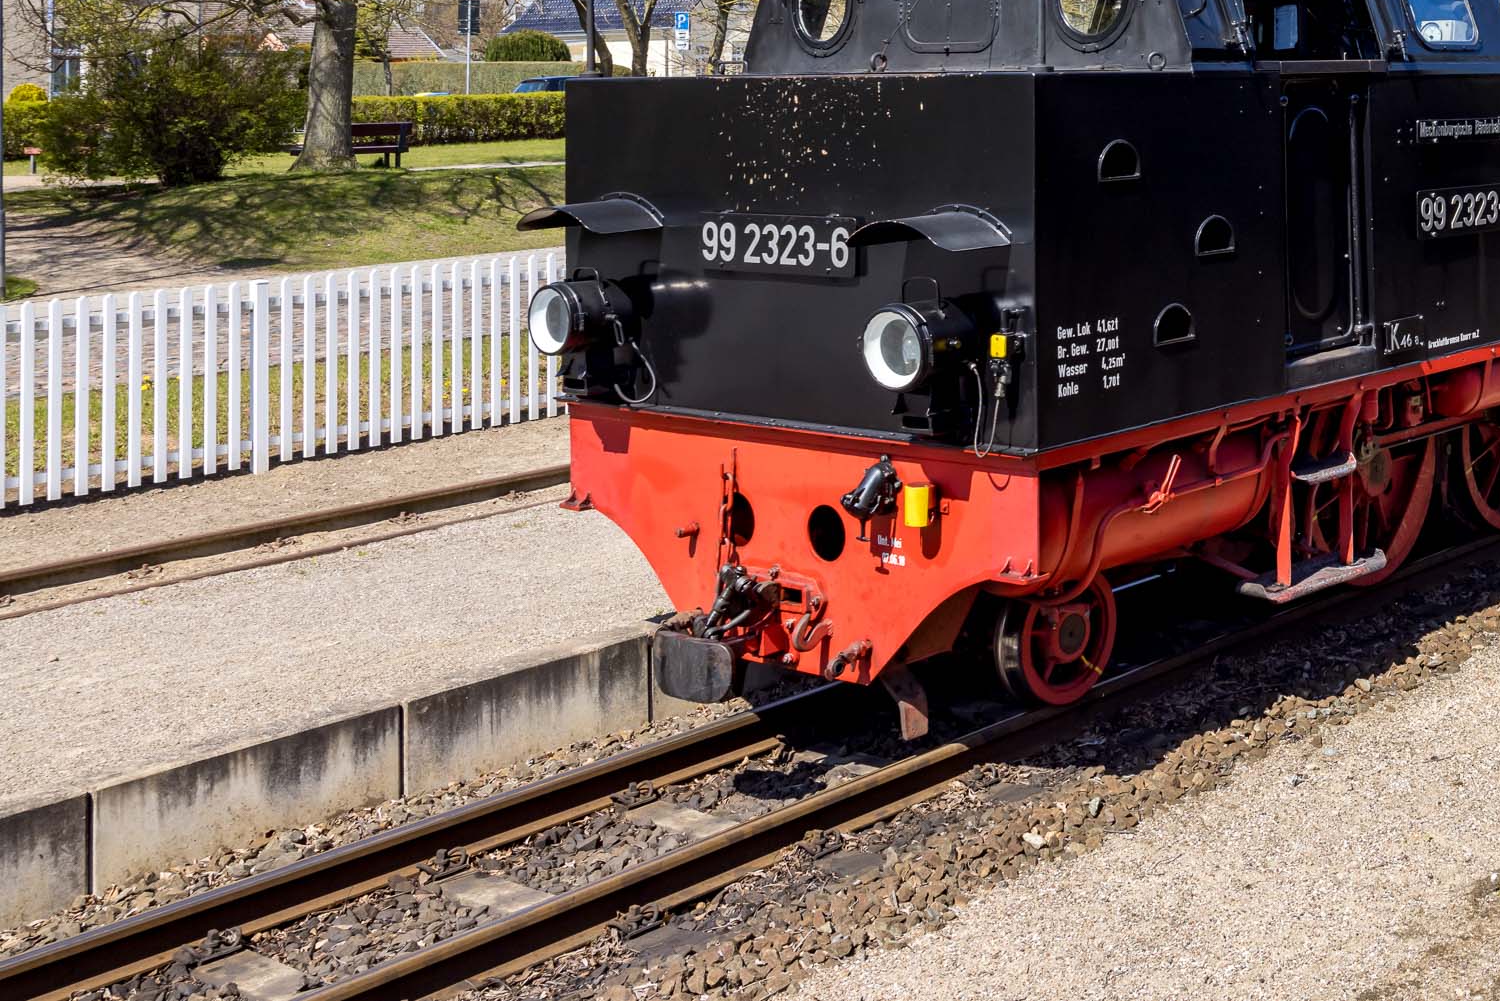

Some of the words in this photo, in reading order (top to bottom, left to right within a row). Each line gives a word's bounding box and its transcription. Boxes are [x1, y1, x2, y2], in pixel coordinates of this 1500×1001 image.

[1421, 196, 1447, 231] 99
[702, 221, 736, 262] 99
[744, 223, 849, 268] 2323-6
[1057, 326, 1076, 340] Gew.
[1077, 321, 1091, 336] Lok
[1057, 345, 1069, 359] Br.
[1071, 342, 1090, 357] Gew.
[1096, 335, 1119, 352] 27,00t
[1057, 363, 1088, 378] Wasser
[1057, 381, 1079, 398] Kohle
